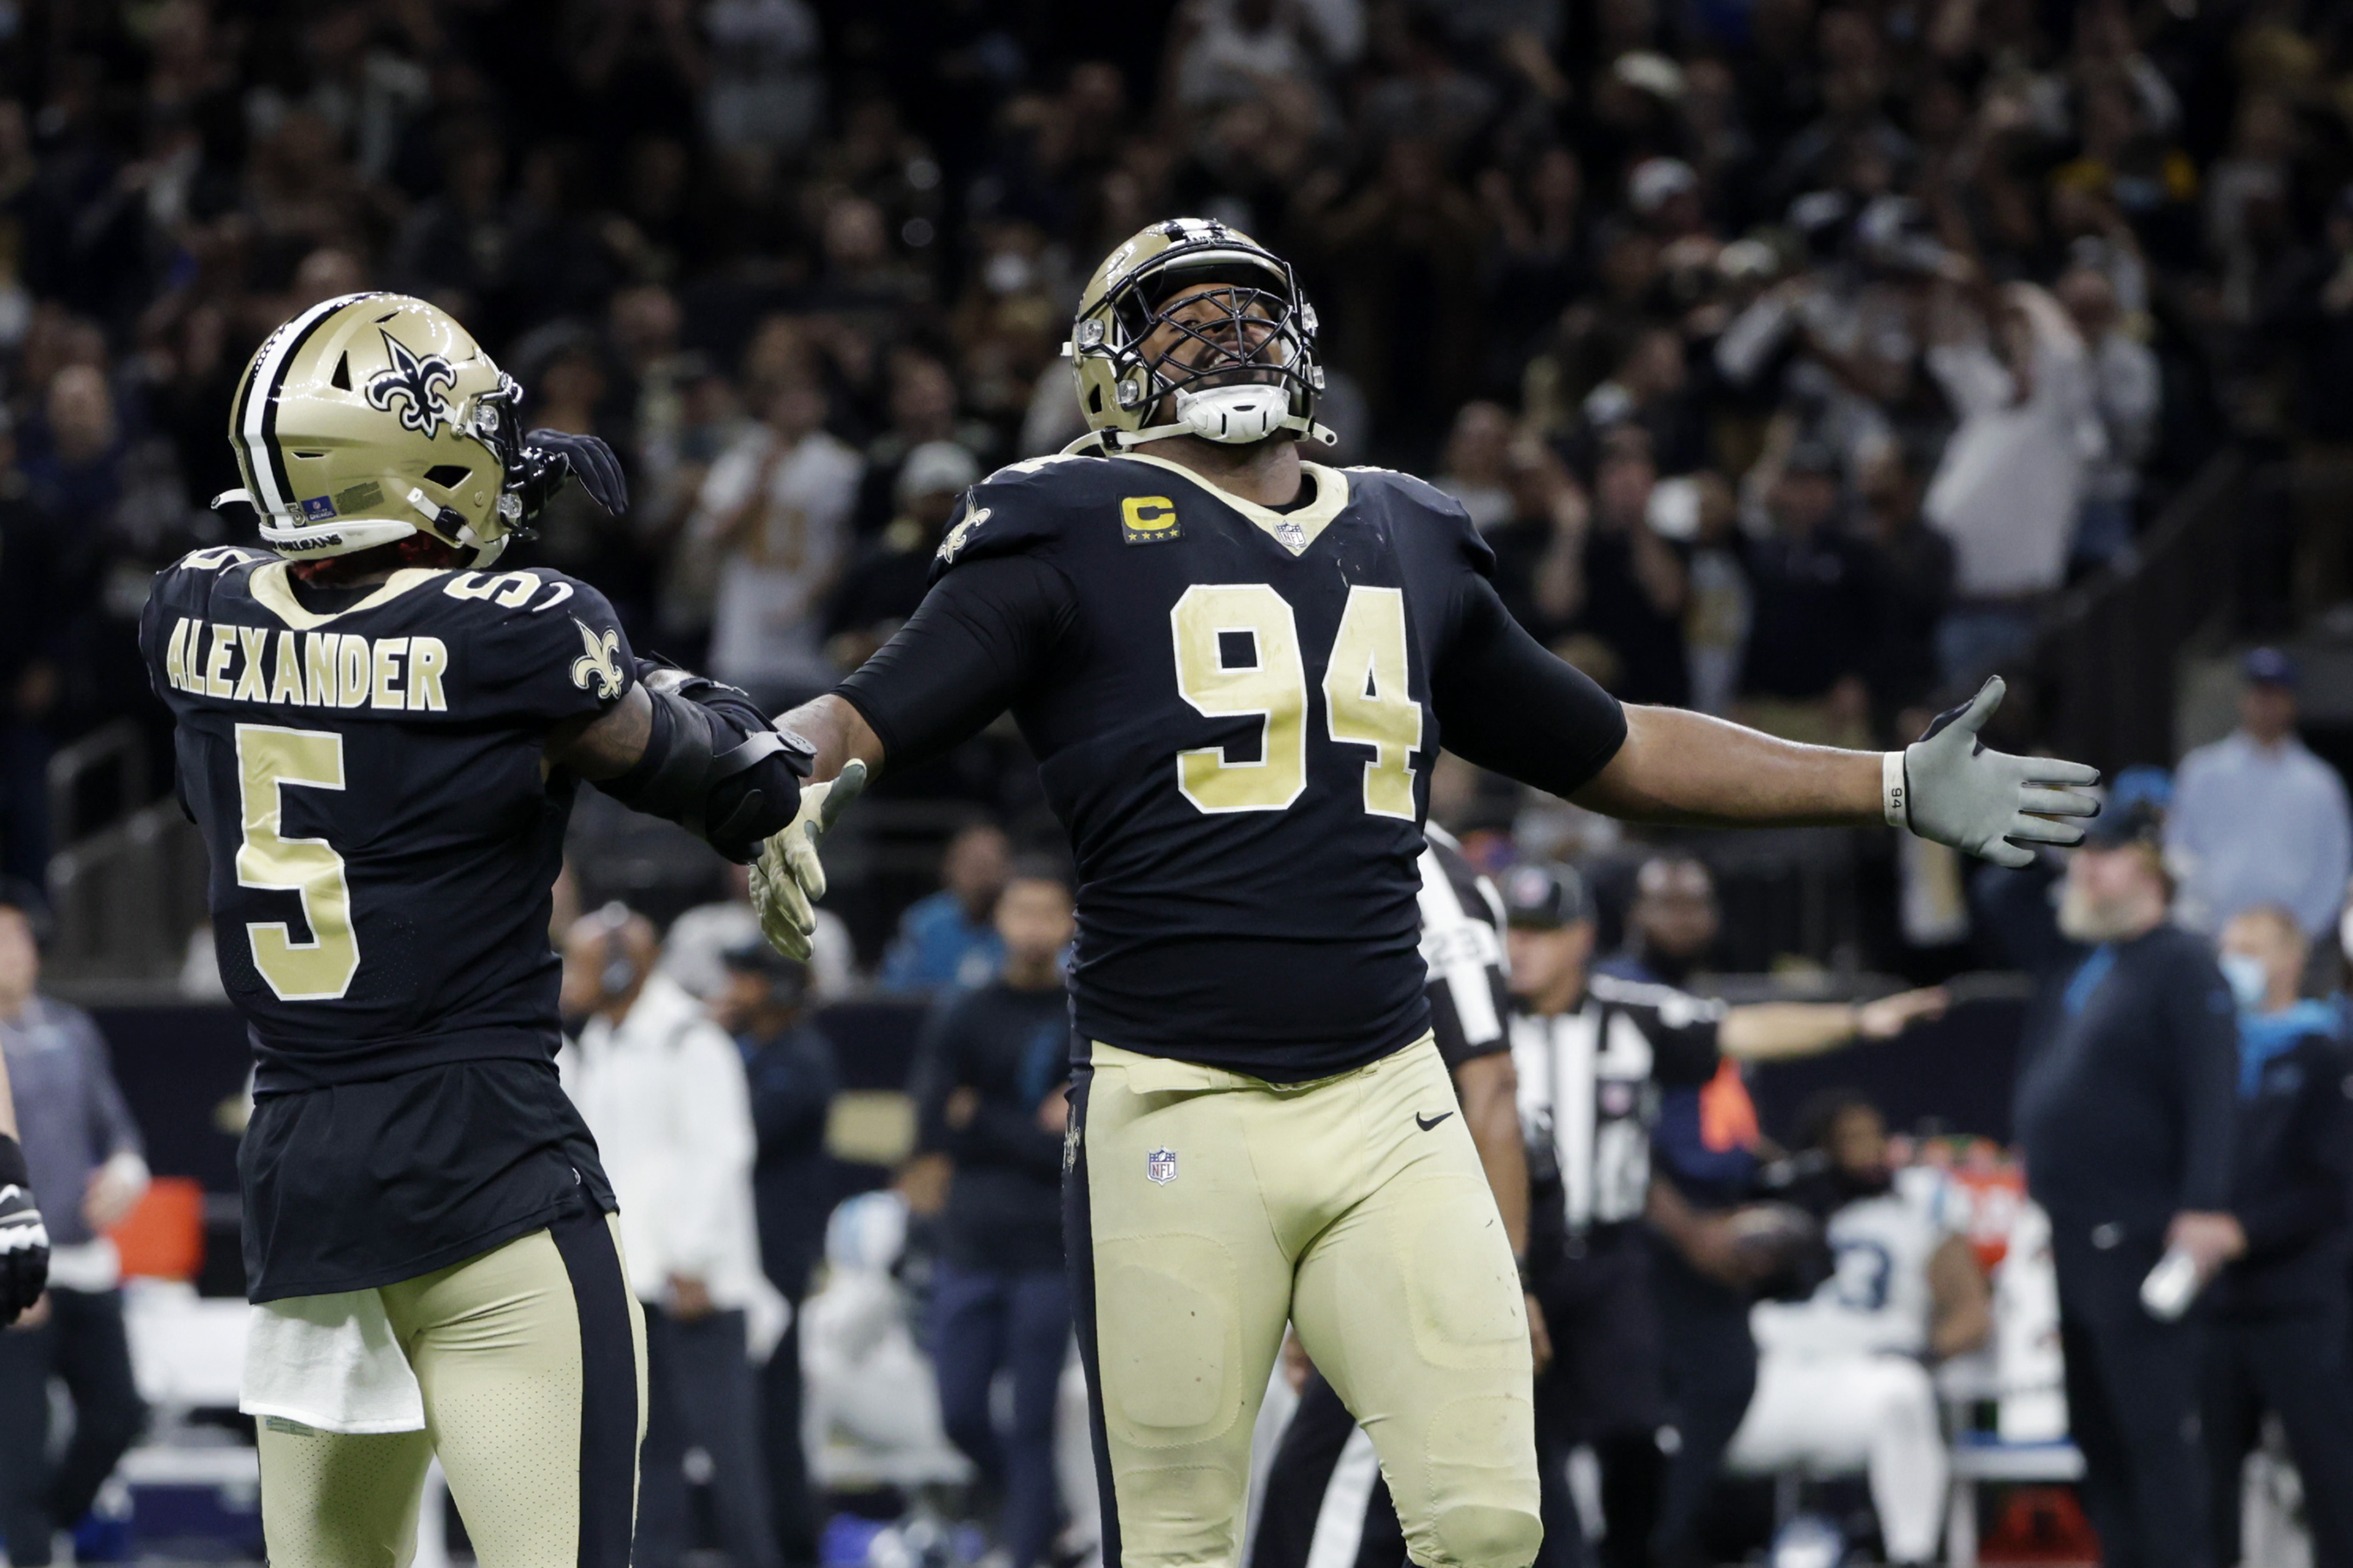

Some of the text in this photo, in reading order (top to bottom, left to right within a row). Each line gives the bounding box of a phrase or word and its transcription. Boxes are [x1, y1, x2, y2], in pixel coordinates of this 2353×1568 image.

[284, 502, 306, 526] 5
[1122, 496, 1176, 530] C
[443, 571, 541, 609] 5
[167, 617, 447, 711] ALEXANDER
[1170, 583, 1423, 823] 94
[1891, 788, 1903, 809] 94
[235, 722, 360, 1001] 5
[1152, 1163, 1173, 1178] NFL
